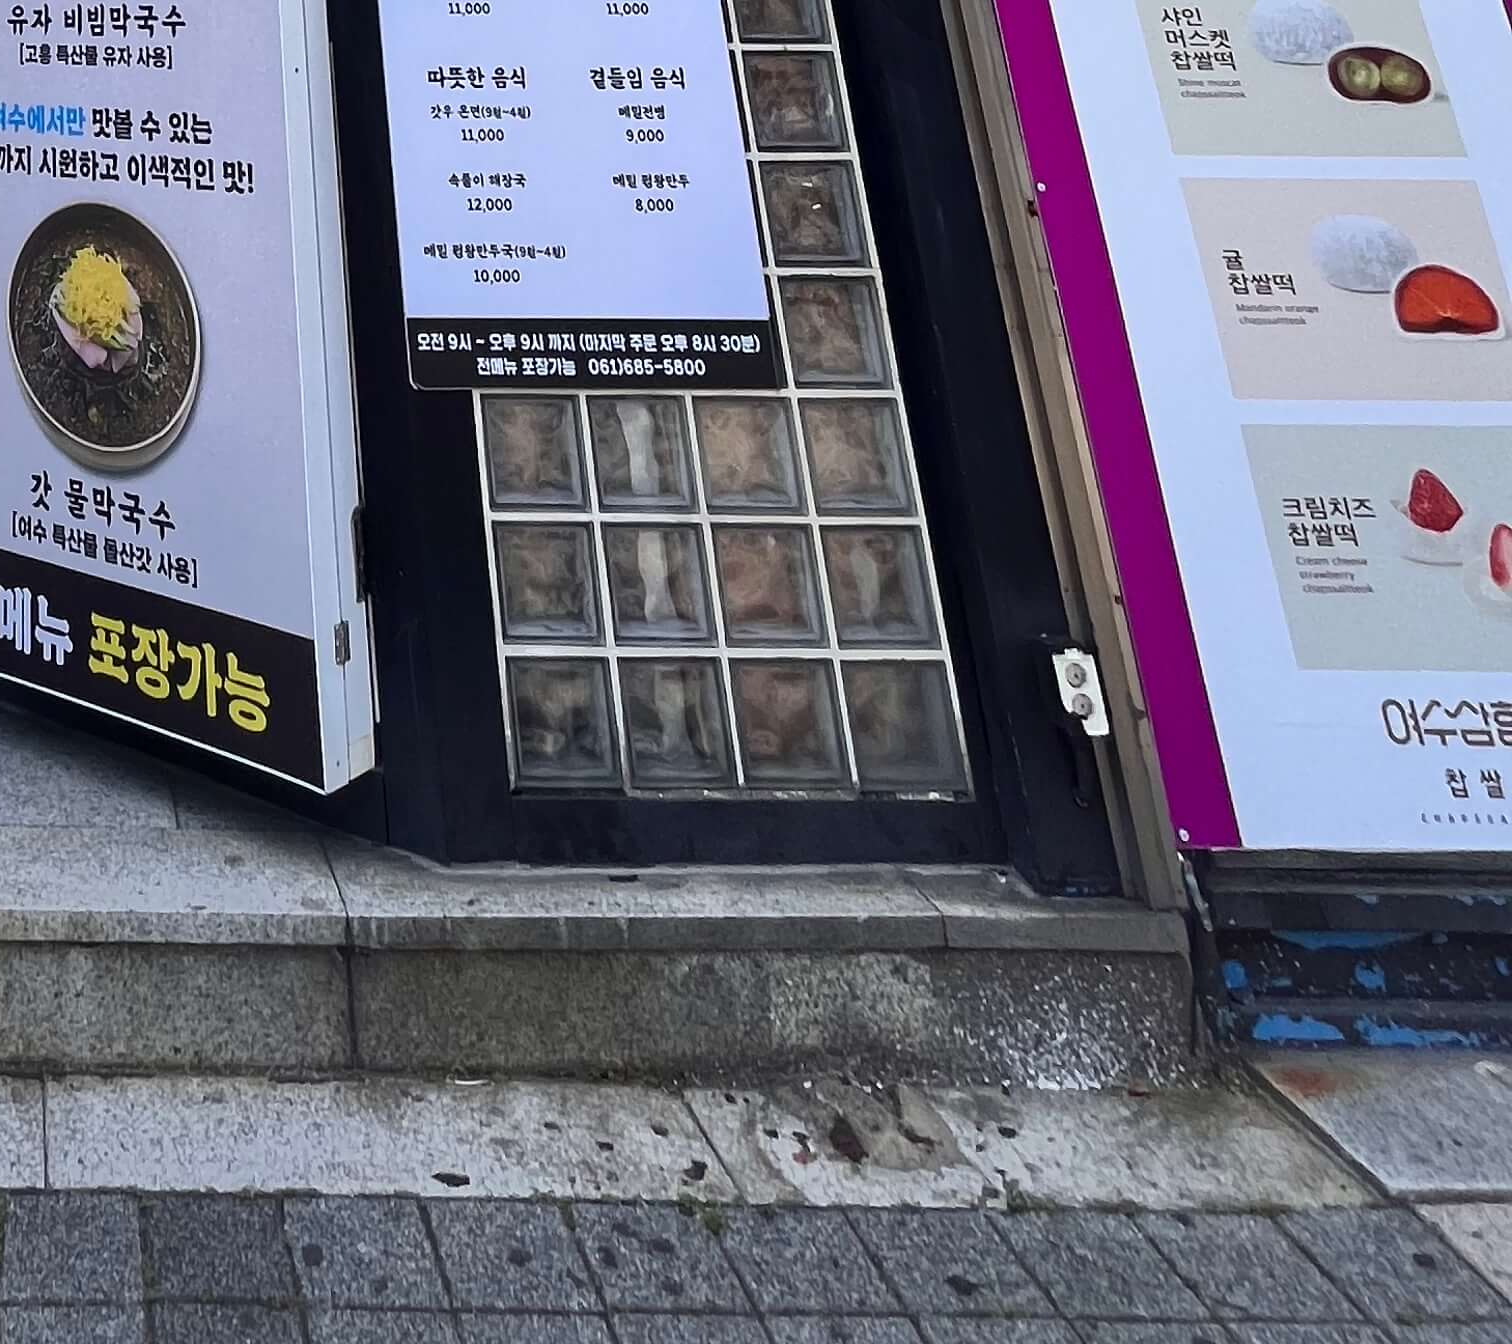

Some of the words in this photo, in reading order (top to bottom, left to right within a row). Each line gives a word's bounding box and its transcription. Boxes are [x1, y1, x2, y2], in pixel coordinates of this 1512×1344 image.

[448, 2, 490, 16] 11,000
[606, 2, 649, 16] 11,000
[1161, 7, 1203, 27] 샤인
[6, 4, 53, 37] 유자
[63, 4, 188, 40] 비빔막국수
[1165, 28, 1231, 50] 머스켓
[102, 45, 132, 68] 유자
[1170, 50, 1237, 72] 찹쌀떡
[428, 66, 484, 89] 따뜻한
[491, 67, 527, 89] 음식
[590, 67, 642, 90] 곁들임
[650, 67, 686, 90] 음식
[92, 108, 133, 140] 맛볼
[140, 111, 162, 142] 수
[168, 112, 213, 145] 있는
[461, 129, 504, 143] 11,000
[626, 129, 664, 143] 9,000
[39, 147, 120, 183] 시원하고
[127, 154, 216, 192] 이색적인
[222, 160, 255, 195] 맛!
[467, 198, 512, 212] 12,000
[635, 198, 674, 213] 8,000
[1222, 249, 1244, 271] 귤
[473, 269, 521, 284] 10,000
[1227, 273, 1297, 296] 찹쌀떡
[417, 334, 445, 351] 오전
[448, 334, 471, 351] 9시
[520, 334, 544, 352] 9시
[548, 334, 576, 352] 까지
[630, 334, 658, 353] 주문
[692, 334, 717, 353] 8시
[476, 358, 518, 377] 전메뉴
[523, 358, 577, 377] 포장가능
[588, 358, 706, 377] 061)685-5800
[31, 470, 53, 512] 갓
[63, 477, 176, 541] 물막국수
[1282, 497, 1376, 521] 크림치즈
[1288, 522, 1359, 548] 찹쌀떡
[88, 611, 271, 732] 포장가능
